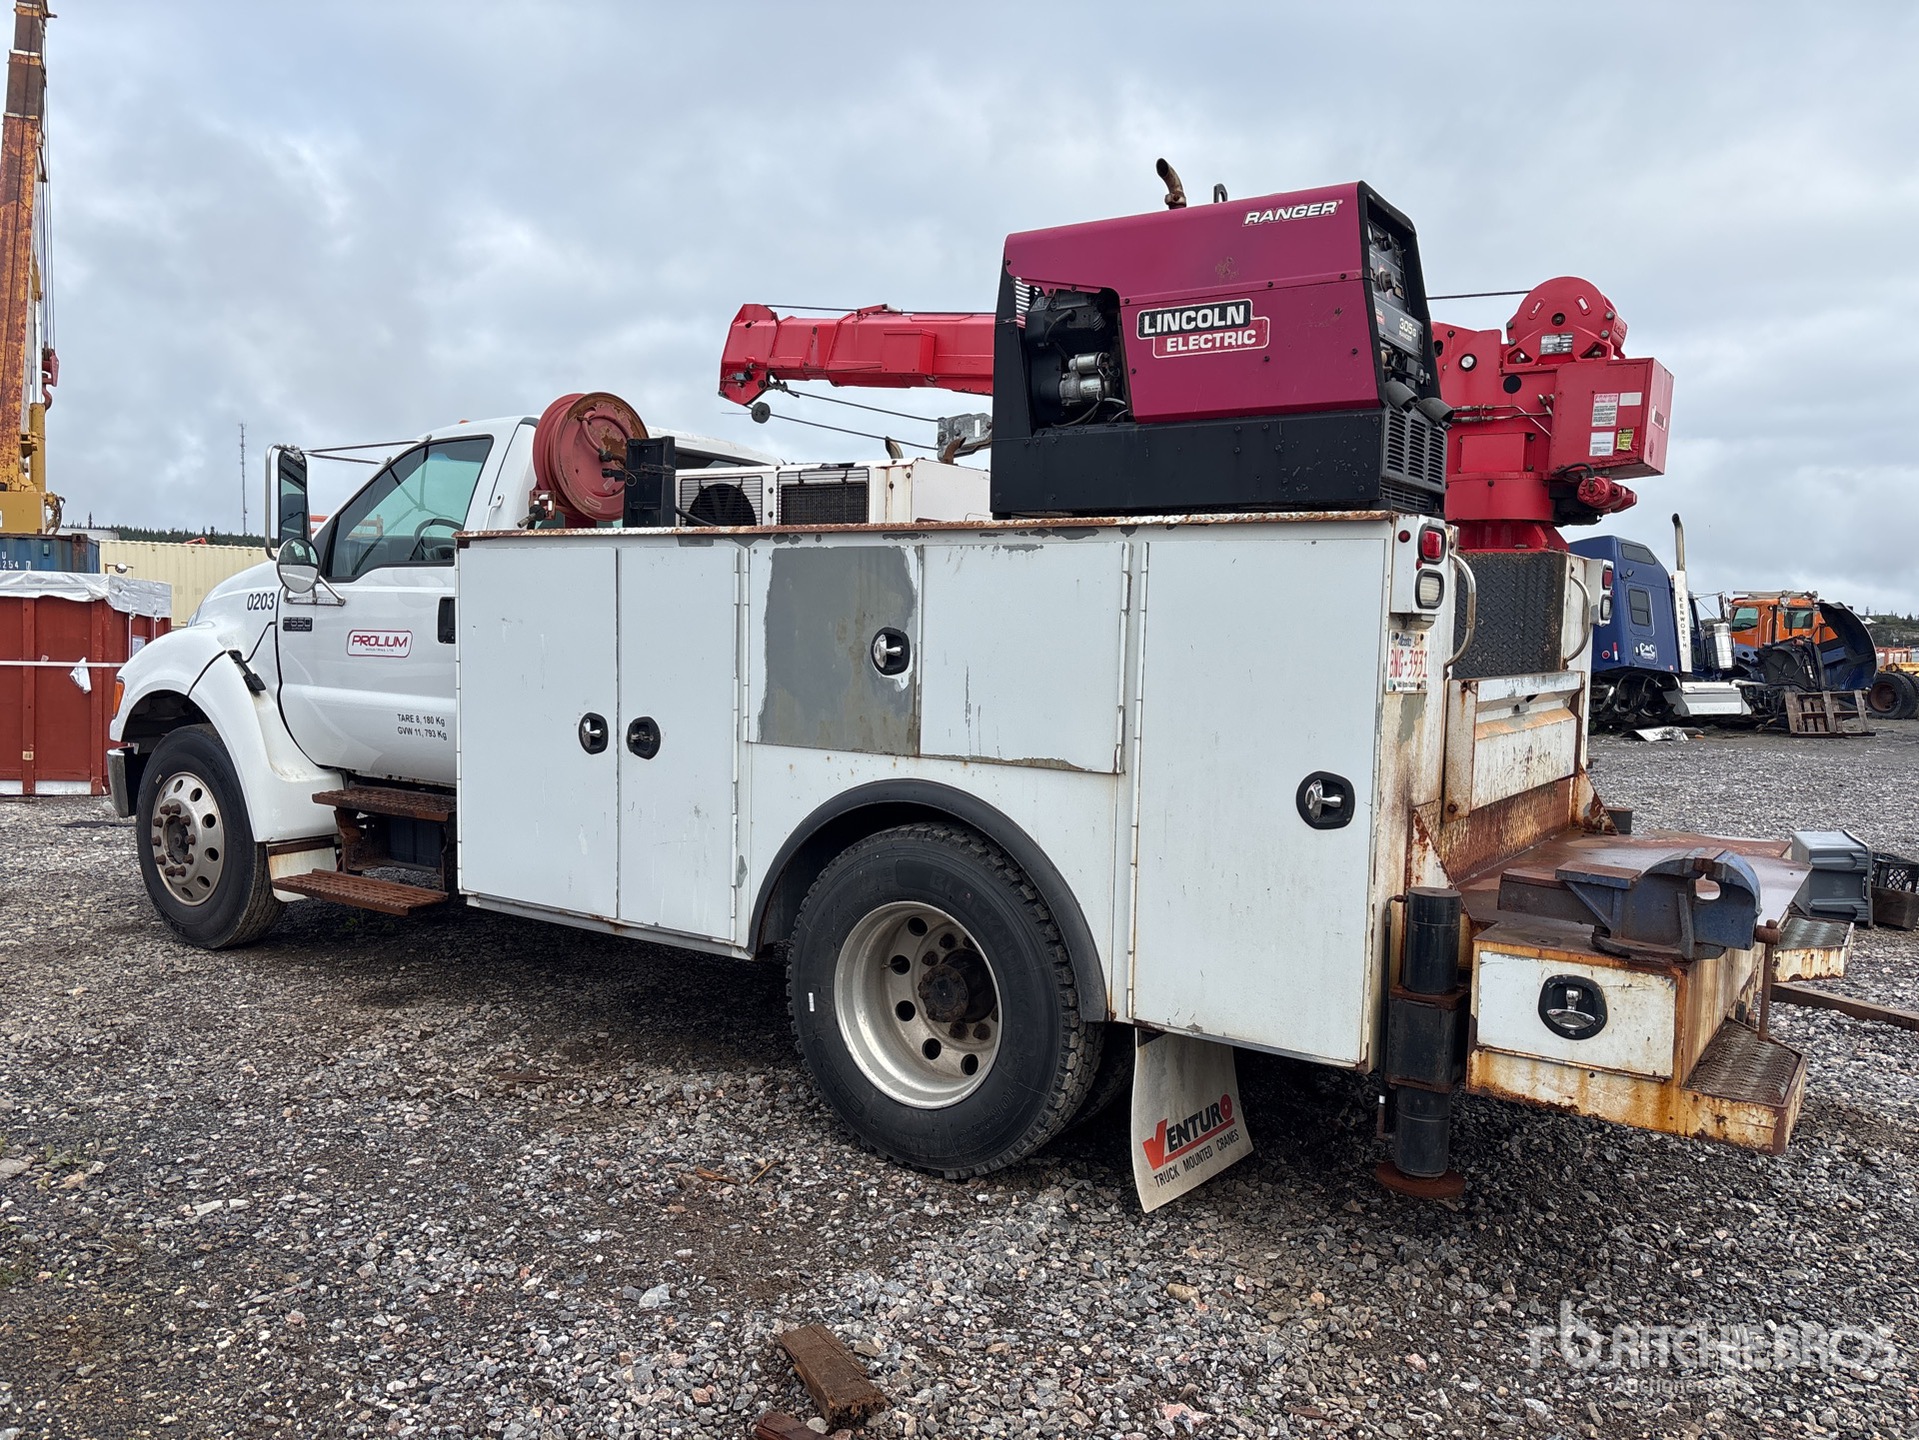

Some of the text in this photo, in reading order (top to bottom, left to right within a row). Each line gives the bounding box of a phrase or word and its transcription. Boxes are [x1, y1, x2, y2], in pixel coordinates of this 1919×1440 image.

[1244, 201, 1338, 225] RANGER
[1143, 304, 1245, 335] LINCOLN
[1166, 329, 1256, 353] ELECTRIC
[246, 592, 275, 611] 0203
[1679, 597, 1687, 648] KENWORTH
[351, 635, 408, 648] PROLIUM
[397, 713, 415, 724] TARE
[423, 715, 435, 725] 180
[435, 716, 446, 728] Kg
[397, 726, 413, 736] GVW
[424, 728, 436, 738] 793
[437, 730, 447, 741] Kg
[1142, 1093, 1234, 1171] VENTURO
[1154, 1129, 1240, 1188] TRUCK MOUNTED CRANES
